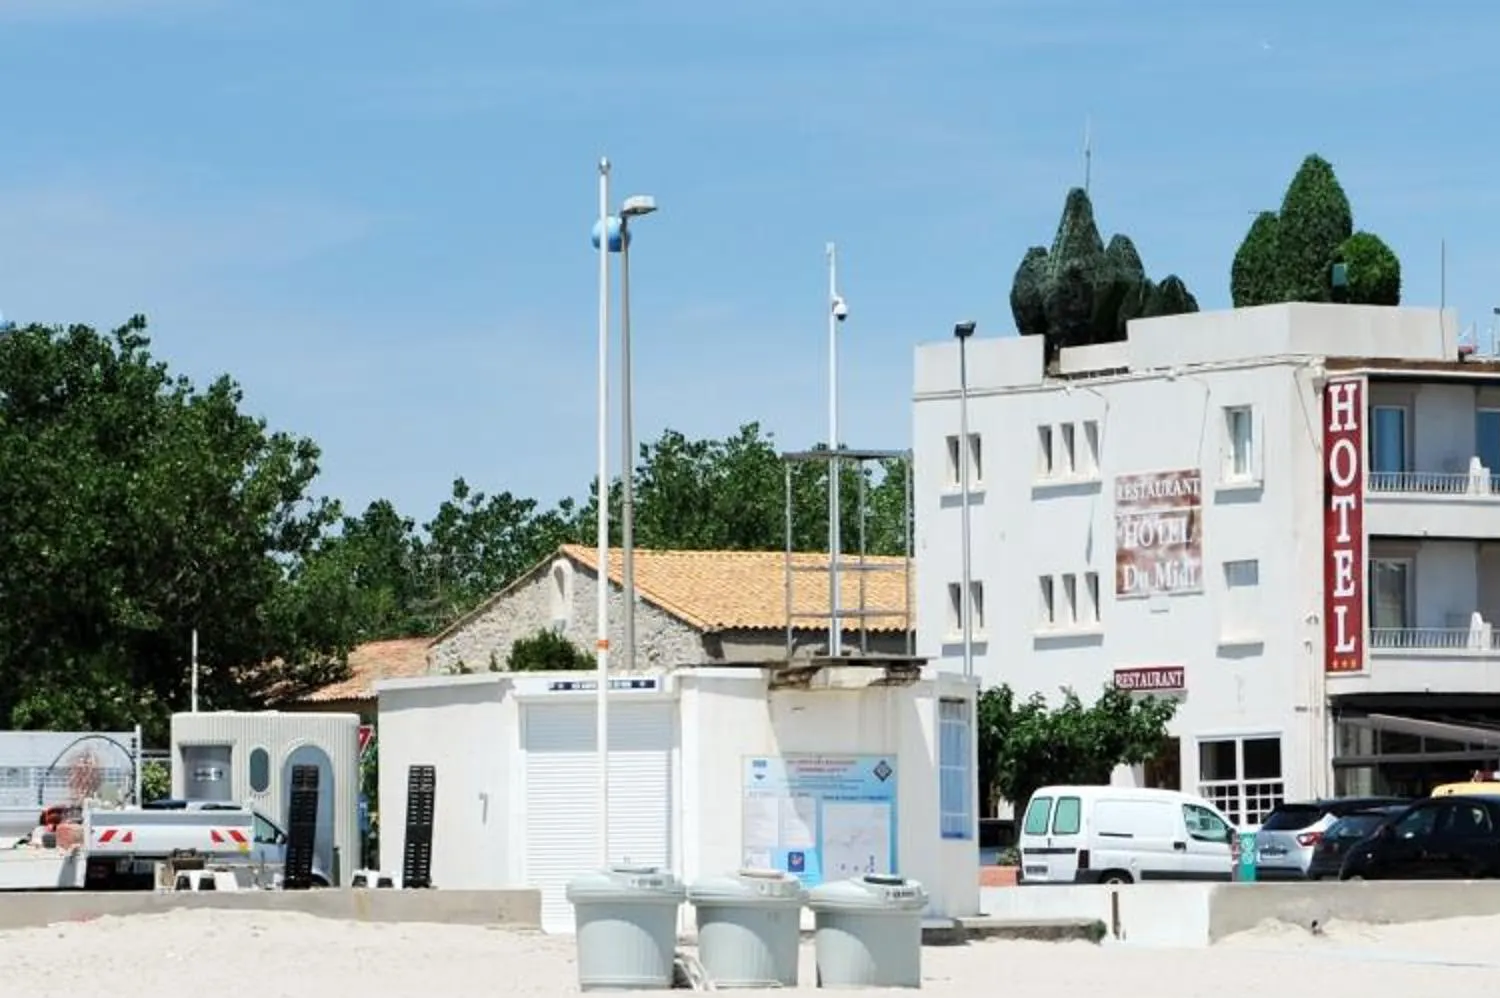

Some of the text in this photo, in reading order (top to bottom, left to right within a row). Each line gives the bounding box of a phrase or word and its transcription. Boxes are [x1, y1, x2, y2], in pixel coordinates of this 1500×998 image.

[1117, 477, 1200, 500] RESTAURANT
[1328, 383, 1359, 653] HOTEL
[1115, 670, 1183, 688] RESTAURANT
